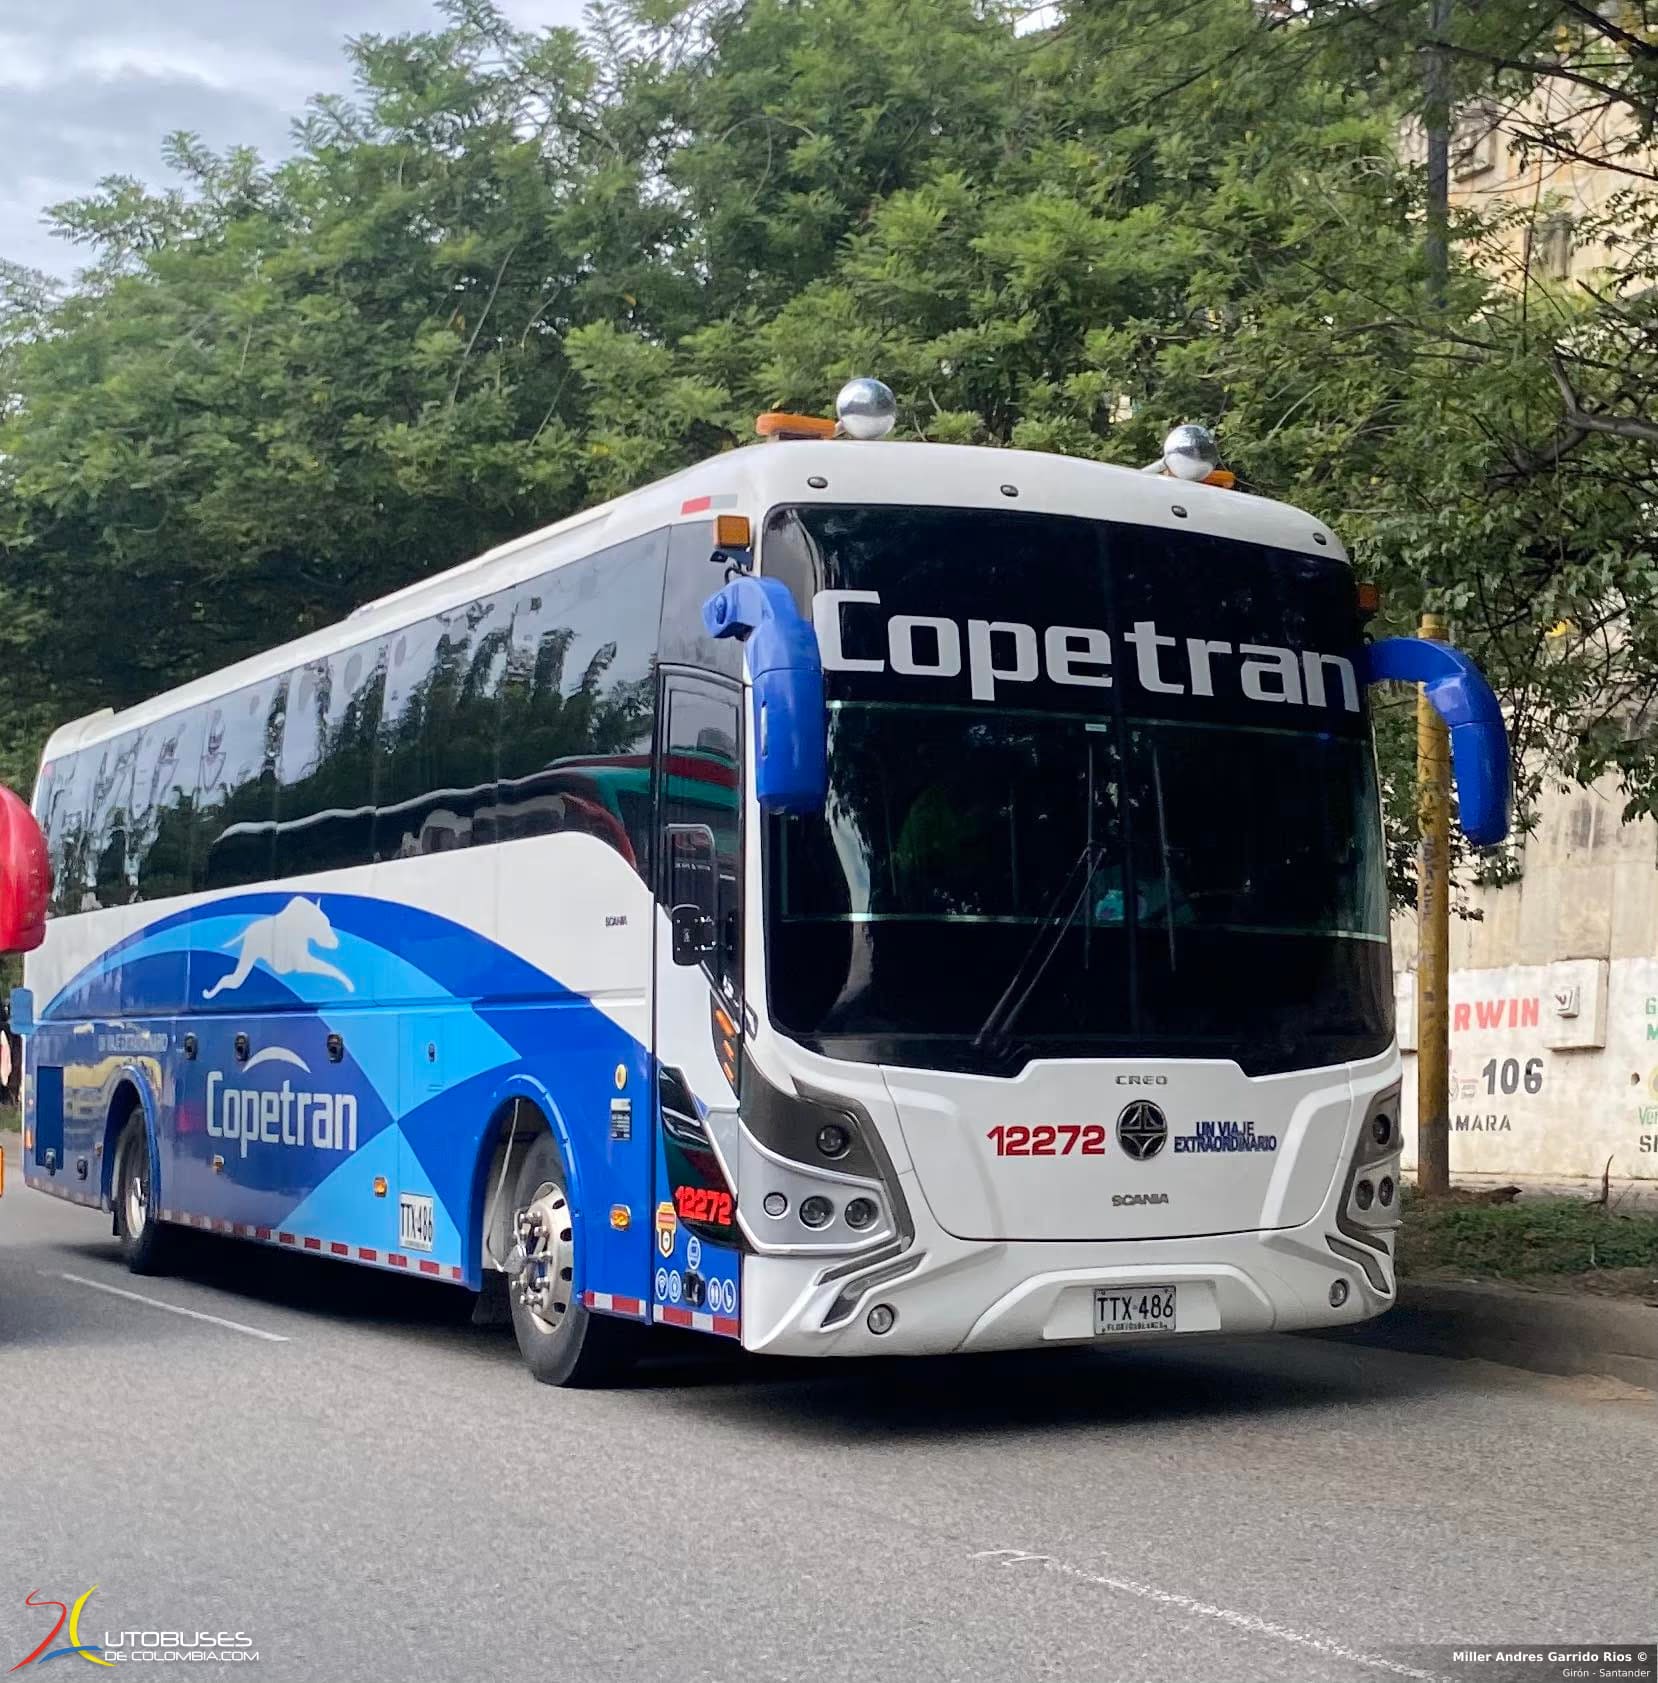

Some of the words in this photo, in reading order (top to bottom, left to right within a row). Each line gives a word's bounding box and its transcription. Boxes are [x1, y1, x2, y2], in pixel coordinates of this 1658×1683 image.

[812, 589, 1361, 713] Copetran
[1115, 1075, 1168, 1085] CREO
[1482, 1057, 1544, 1095] 106
[206, 1070, 358, 1158] Copetran
[1196, 1121, 1215, 1137] UN
[1217, 1121, 1255, 1137] VIAJE
[987, 1125, 1106, 1156] 12272
[1174, 1135, 1277, 1153] EXTRAORDINARIO
[675, 1186, 732, 1225] 12272
[1112, 1194, 1168, 1206] SCANIA
